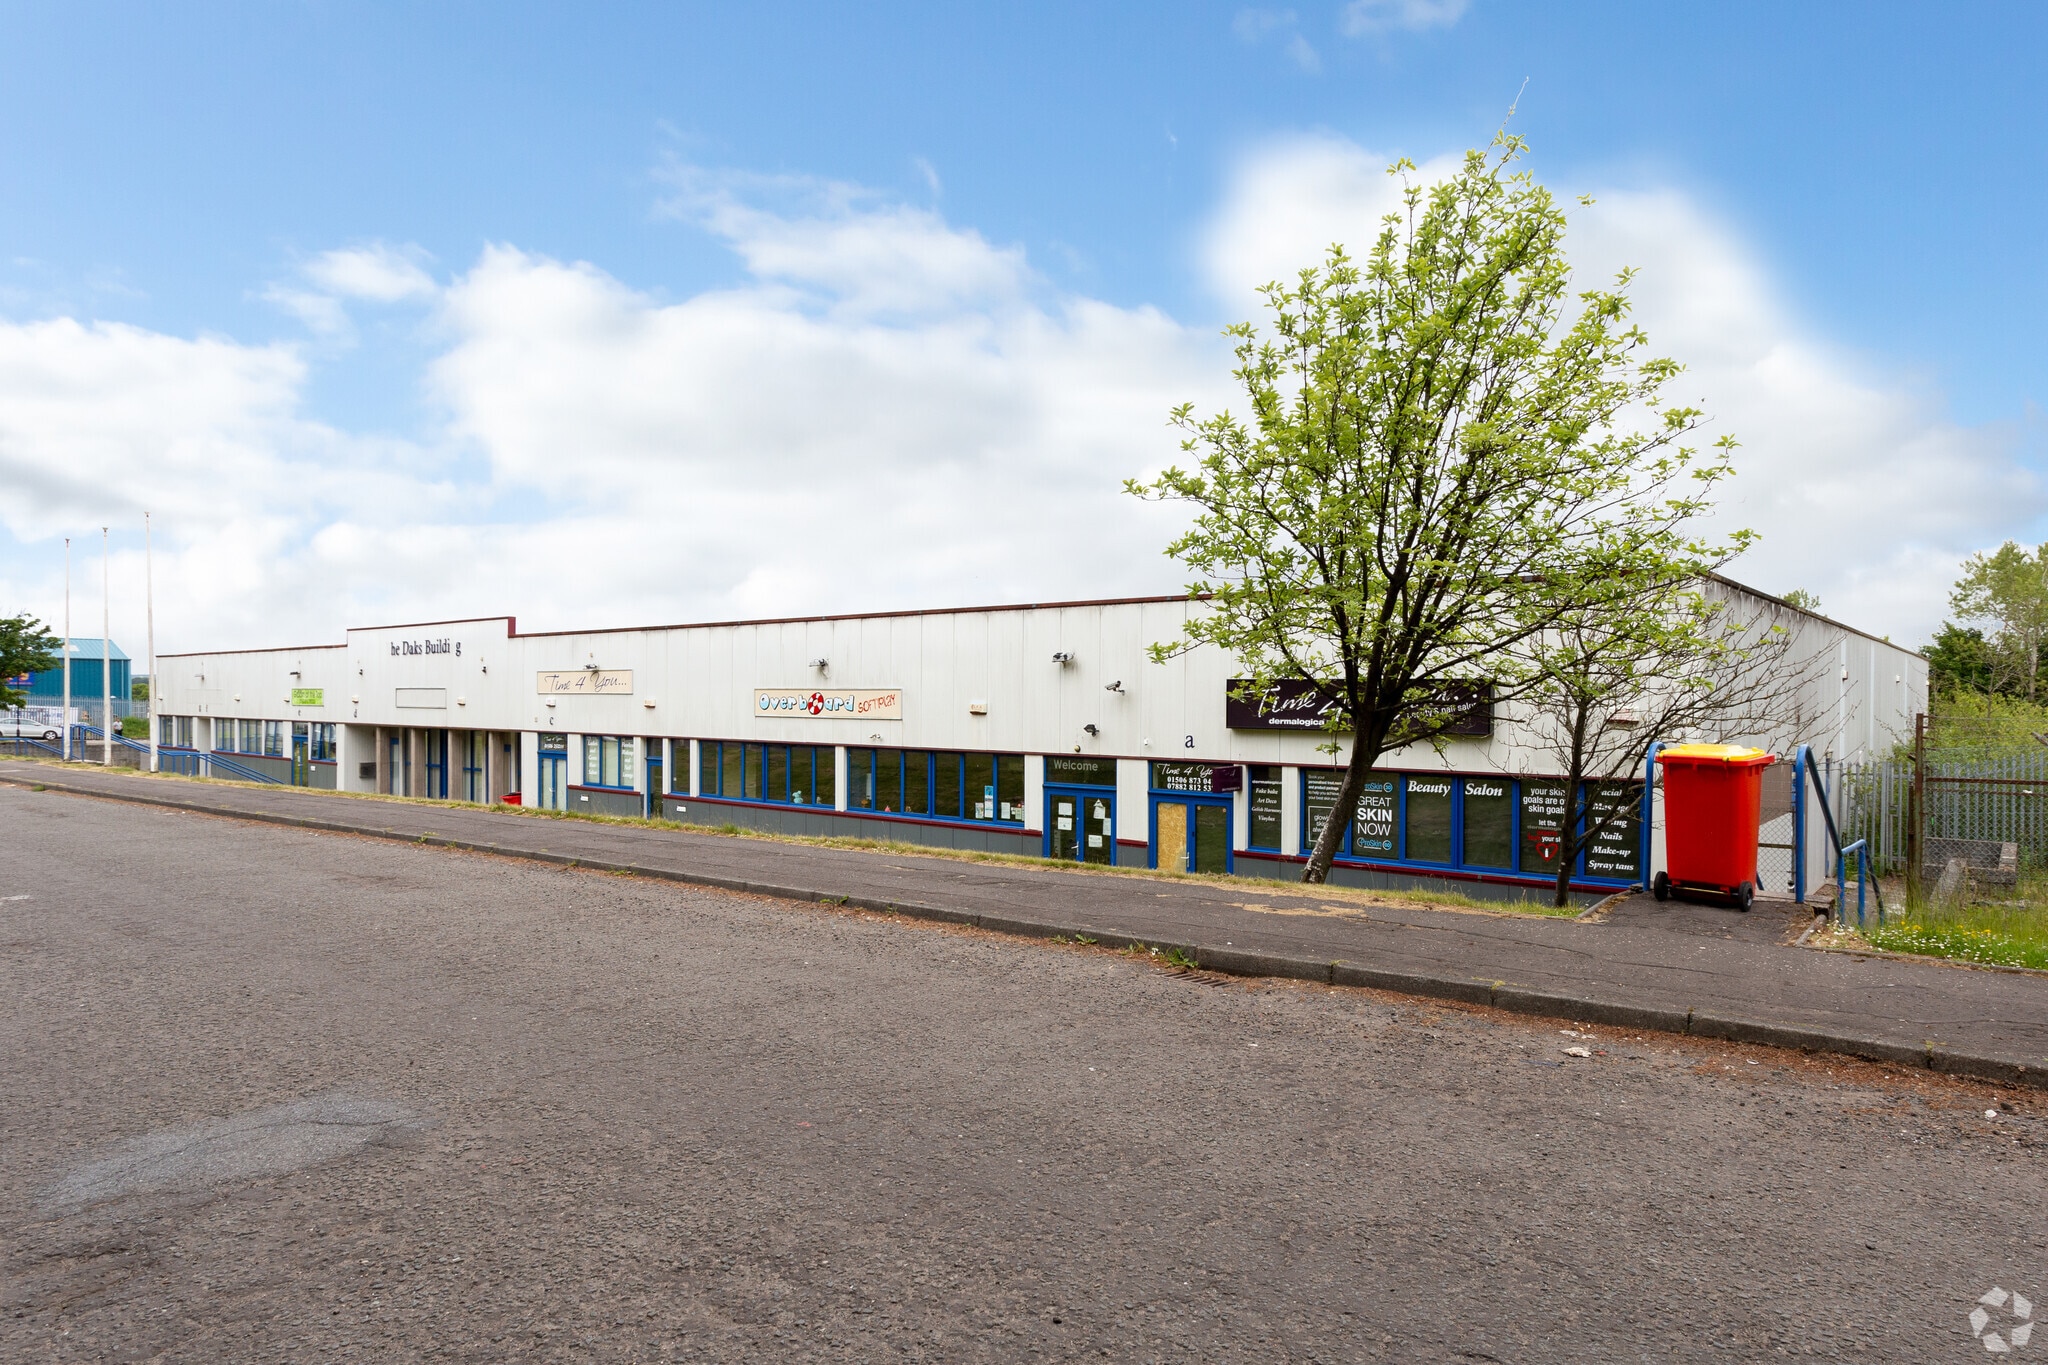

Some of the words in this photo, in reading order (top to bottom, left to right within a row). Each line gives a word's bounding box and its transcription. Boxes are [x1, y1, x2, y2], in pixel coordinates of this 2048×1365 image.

[402, 640, 422, 655] Daks
[425, 638, 461, 657] Buildig
[544, 674, 571, 692] Time
[575, 676, 586, 690] 4
[1241, 684, 1316, 718] Time
[1268, 717, 1325, 726] dermalogica
[1185, 735, 1195, 748] a
[1053, 759, 1099, 771] Welcome
[1156, 763, 1181, 775] Time
[1183, 766, 1194, 775] 4
[1167, 776, 1187, 784] 01506
[1188, 777, 1201, 785] 873
[1202, 777, 1212, 785] 04
[1203, 784, 1213, 792] 53
[1407, 780, 1451, 797] Beauty
[1464, 783, 1503, 797] Salon
[1530, 788, 1548, 796] your
[1600, 788, 1623, 797] acial
[1357, 795, 1392, 807] GREAT
[1523, 796, 1544, 805] goals
[1545, 797, 1558, 805] are
[1528, 804, 1544, 813] skin
[1357, 807, 1392, 822] SKIN
[1547, 819, 1557, 827] the
[1357, 822, 1391, 836] NOW
[1600, 832, 1623, 841] Nails
[1592, 846, 1631, 857] Make-up
[1588, 860, 1614, 871] Spray
[1615, 862, 1634, 871] tans
